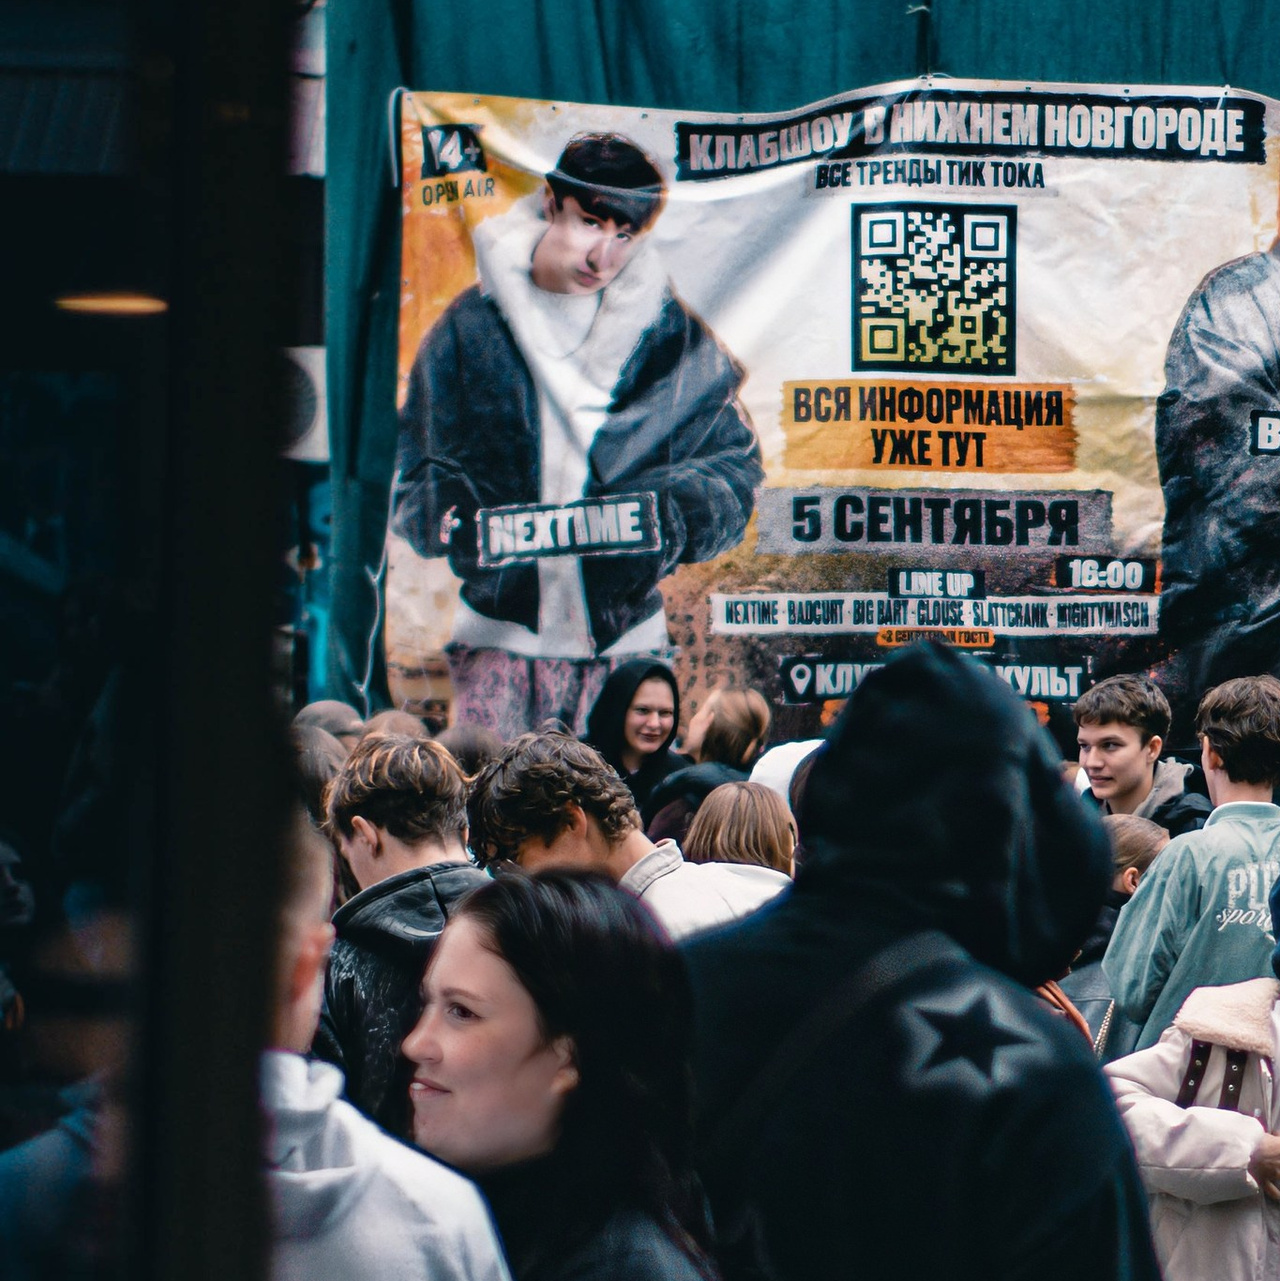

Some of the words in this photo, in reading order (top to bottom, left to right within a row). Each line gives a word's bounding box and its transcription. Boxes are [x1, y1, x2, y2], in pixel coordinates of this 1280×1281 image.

[428, 129, 481, 170] 14+
[689, 111, 853, 171] КЛАБШОУ
[863, 105, 887, 145] В
[890, 100, 1038, 146] НИЖНЕМ
[1044, 104, 1245, 156] НОВГОРОДЕ
[463, 177, 495, 199] AIR
[815, 162, 851, 189] ВСЕ
[856, 159, 941, 187] ТРЕНДЫ
[946, 161, 986, 187] ТИК
[991, 161, 1045, 189] ТОКА
[793, 386, 852, 423] ВСЯ
[858, 386, 1064, 430] ИНФОРМАЦИЯ
[871, 428, 932, 467] УЖЕ
[937, 430, 987, 468] ТУТ
[488, 501, 643, 556] NEXTIME
[792, 495, 822, 543] 5
[833, 494, 1080, 547] СЕНТЯБРЯ
[899, 571, 944, 597] LINE
[946, 572, 975, 597] UP
[1069, 558, 1144, 590] 16:00
[725, 599, 779, 625] NEXTIME
[787, 598, 845, 626] BADCURT
[852, 599, 874, 626] BIG
[876, 599, 909, 626] BART
[815, 663, 887, 696] КЛУ
